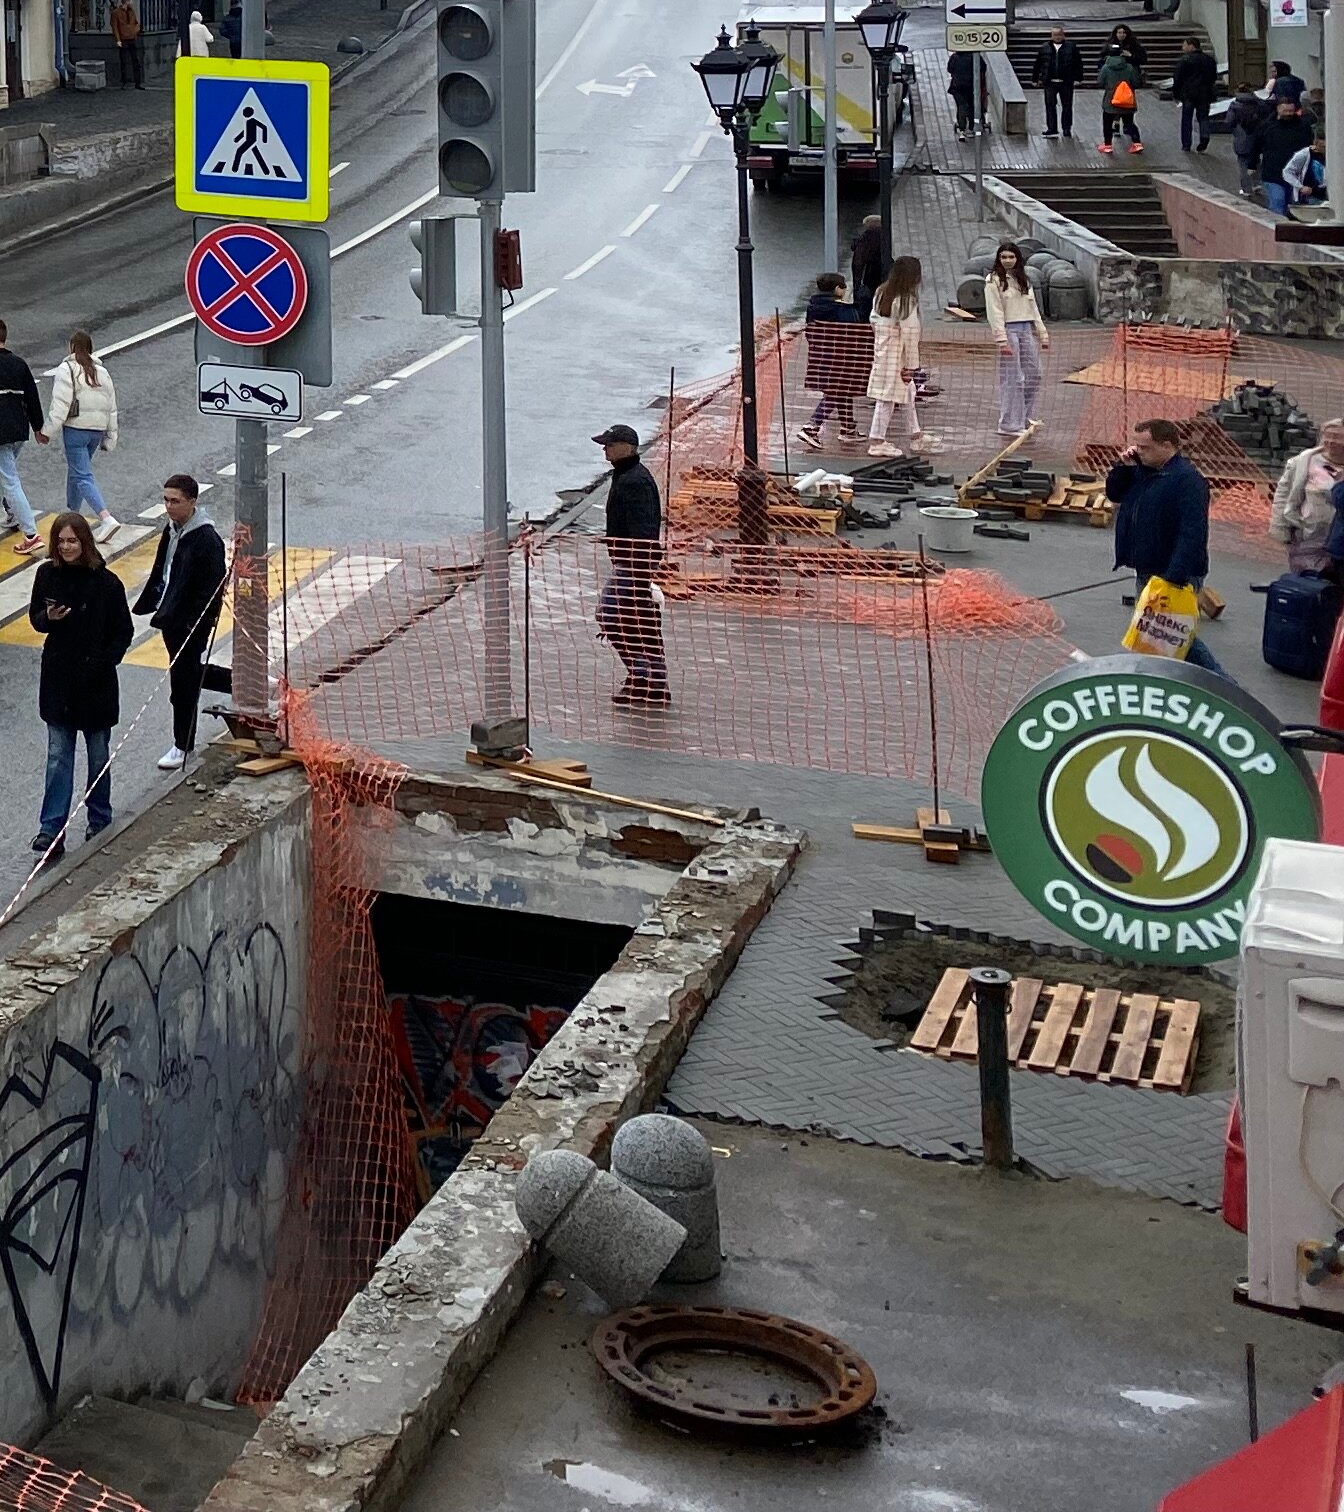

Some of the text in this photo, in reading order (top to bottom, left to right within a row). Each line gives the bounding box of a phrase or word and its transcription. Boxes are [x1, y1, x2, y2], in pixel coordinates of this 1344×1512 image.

[967, 32, 978, 40] 15
[982, 31, 1000, 44] 20
[1018, 685, 1277, 777] COFFEESHOP
[1044, 879, 1246, 954] COMPANY
